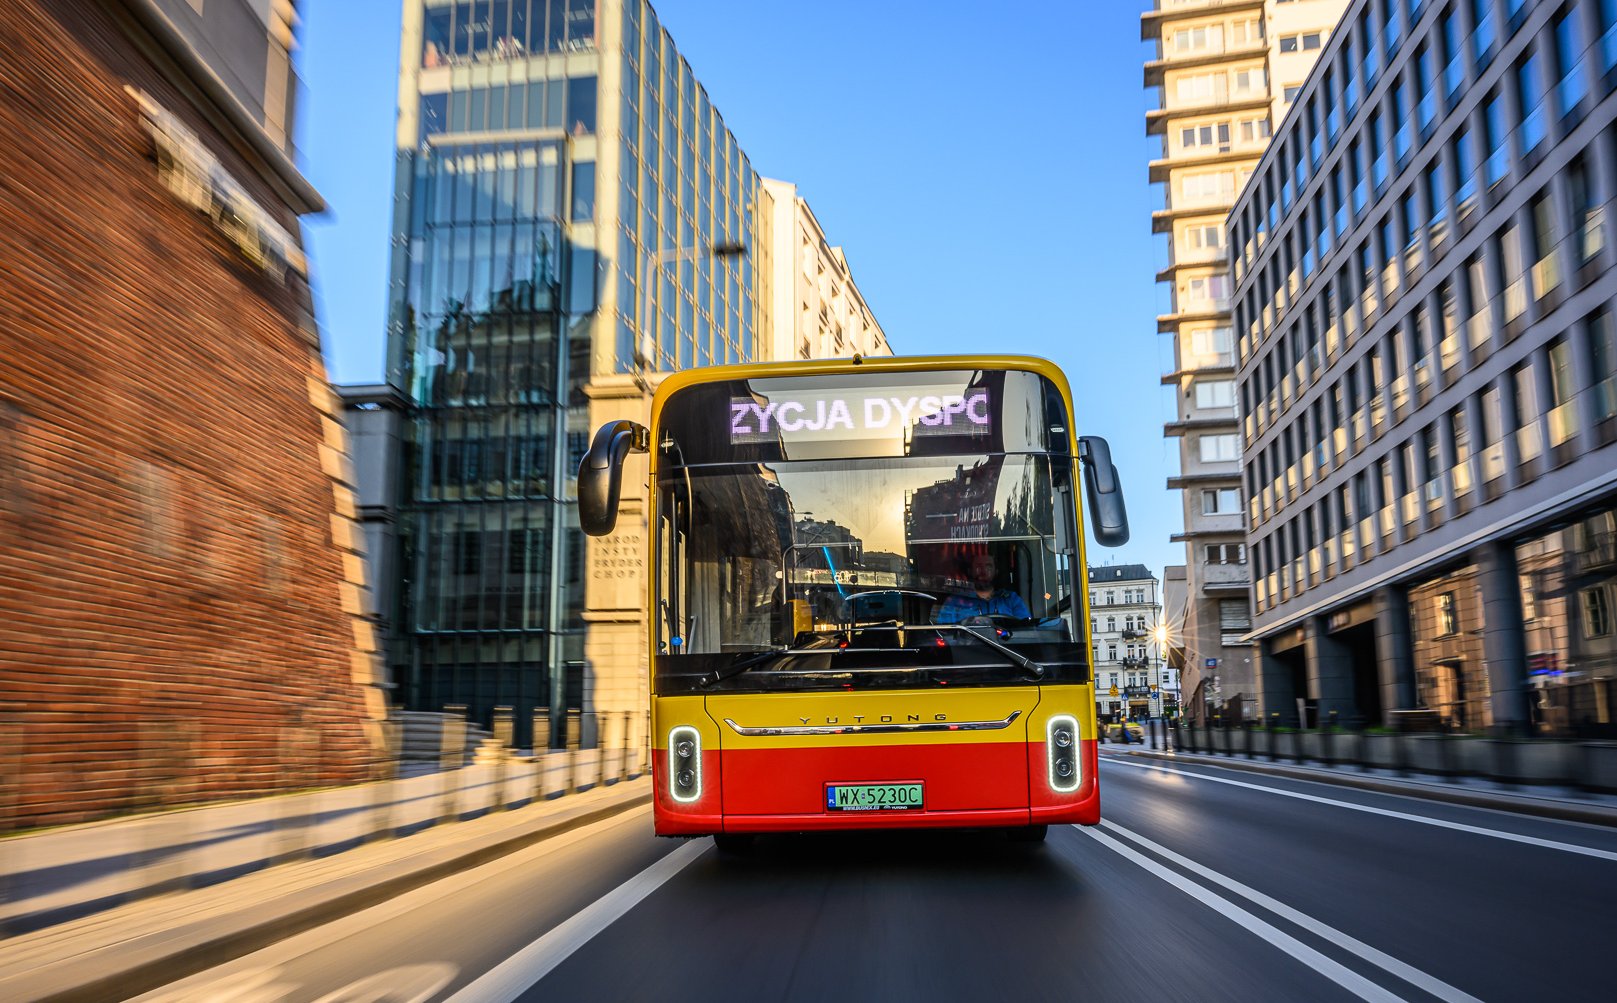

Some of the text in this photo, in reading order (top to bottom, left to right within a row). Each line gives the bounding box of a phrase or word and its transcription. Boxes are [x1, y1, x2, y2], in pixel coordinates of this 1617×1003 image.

[732, 400, 854, 433] ZYCJA
[800, 714, 947, 725] YUTONG
[839, 787, 918, 805] WX 5230C
